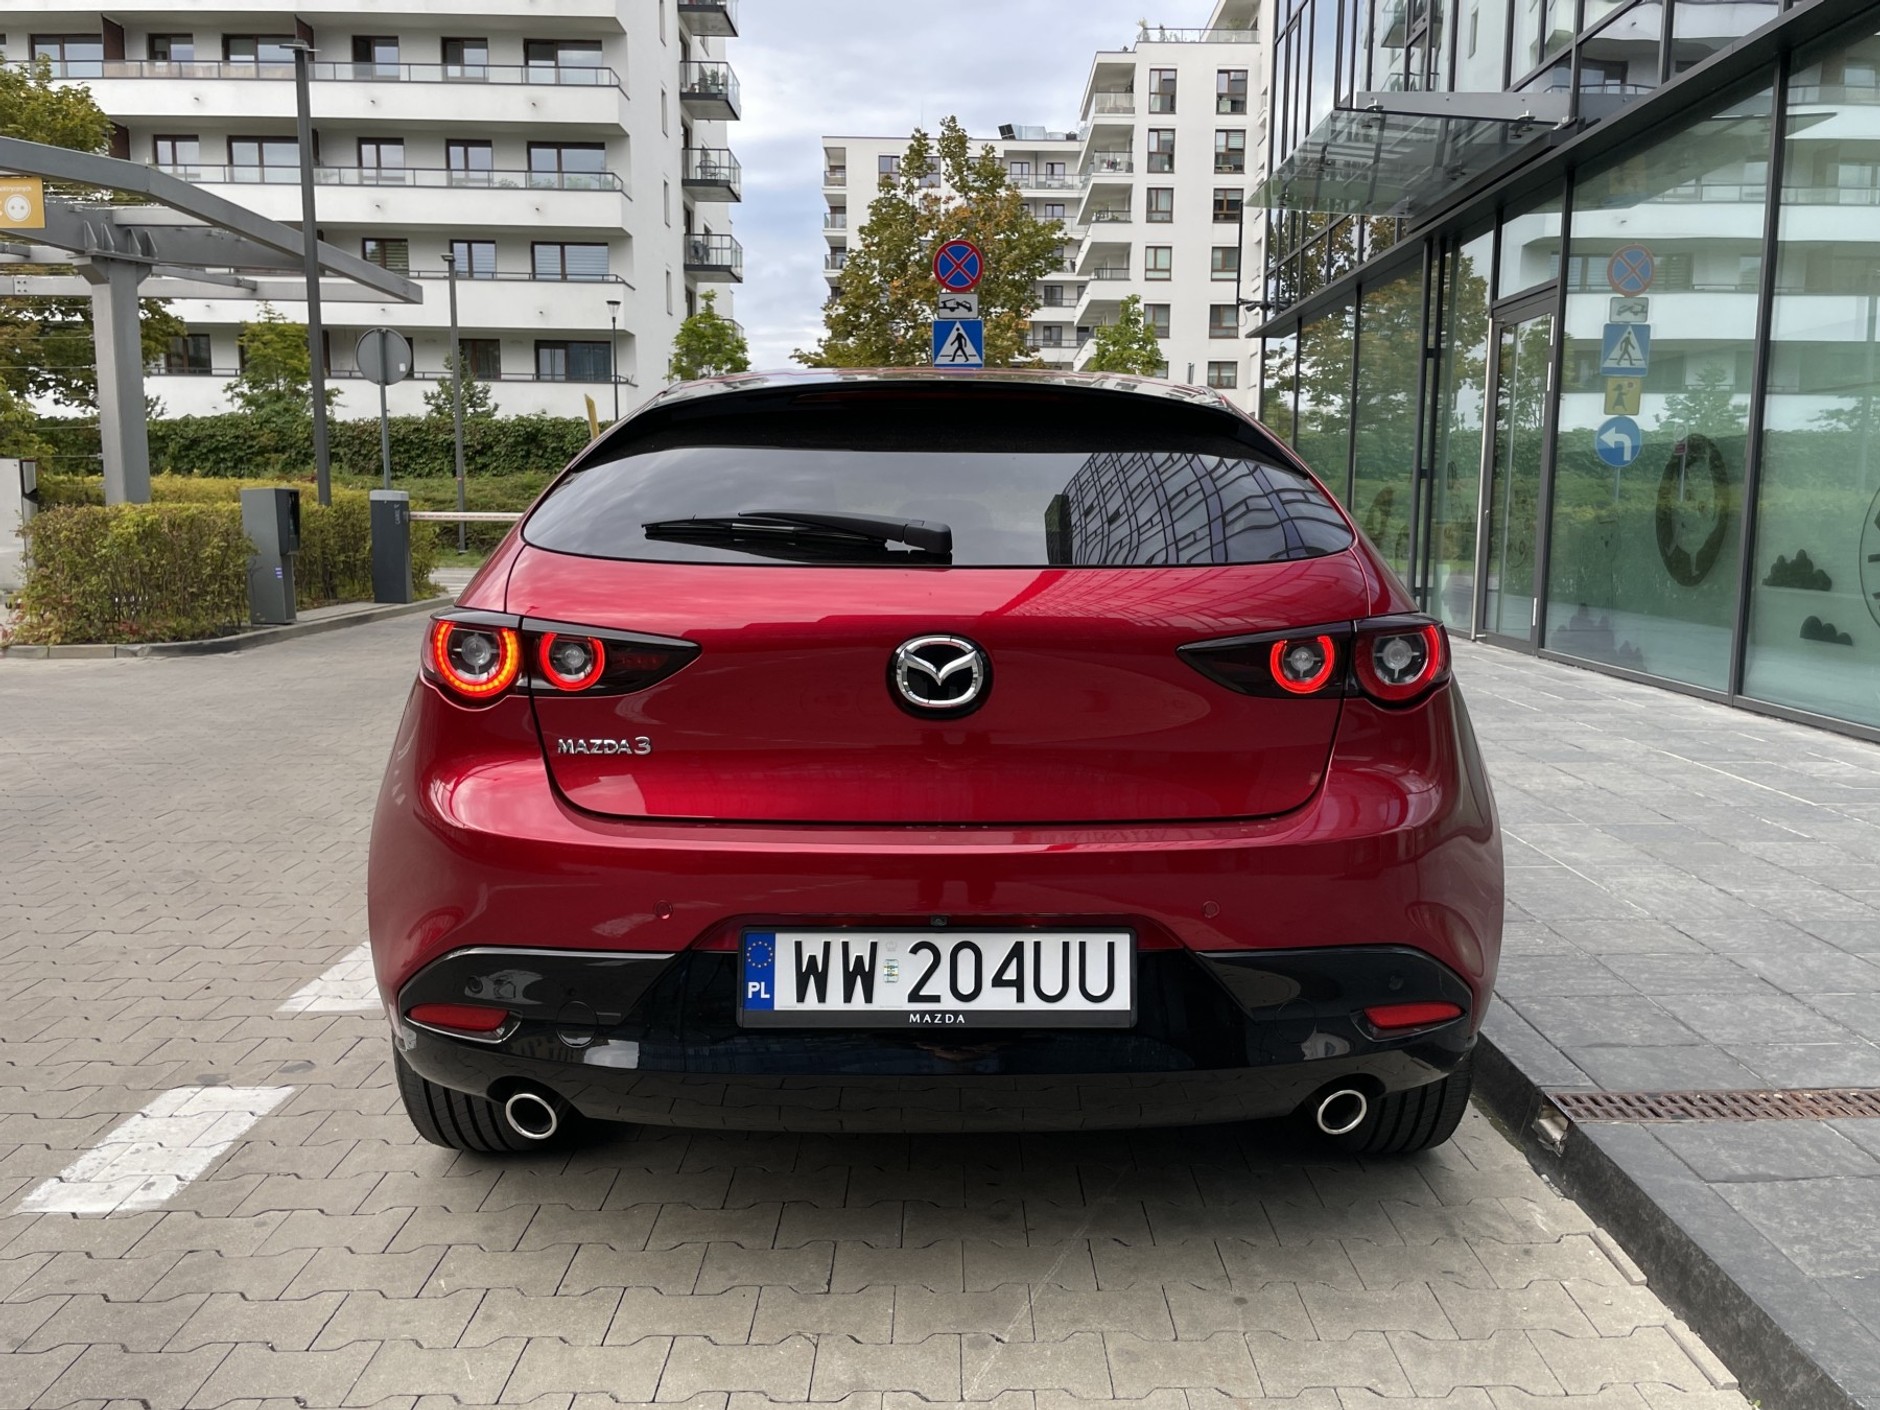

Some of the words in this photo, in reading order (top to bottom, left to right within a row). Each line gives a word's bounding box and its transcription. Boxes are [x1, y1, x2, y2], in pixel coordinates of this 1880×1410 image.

[794, 940, 878, 1003] WW
[907, 940, 1115, 1003] 204UU
[748, 981, 770, 999] PL
[909, 1013, 965, 1024] MAZDA
